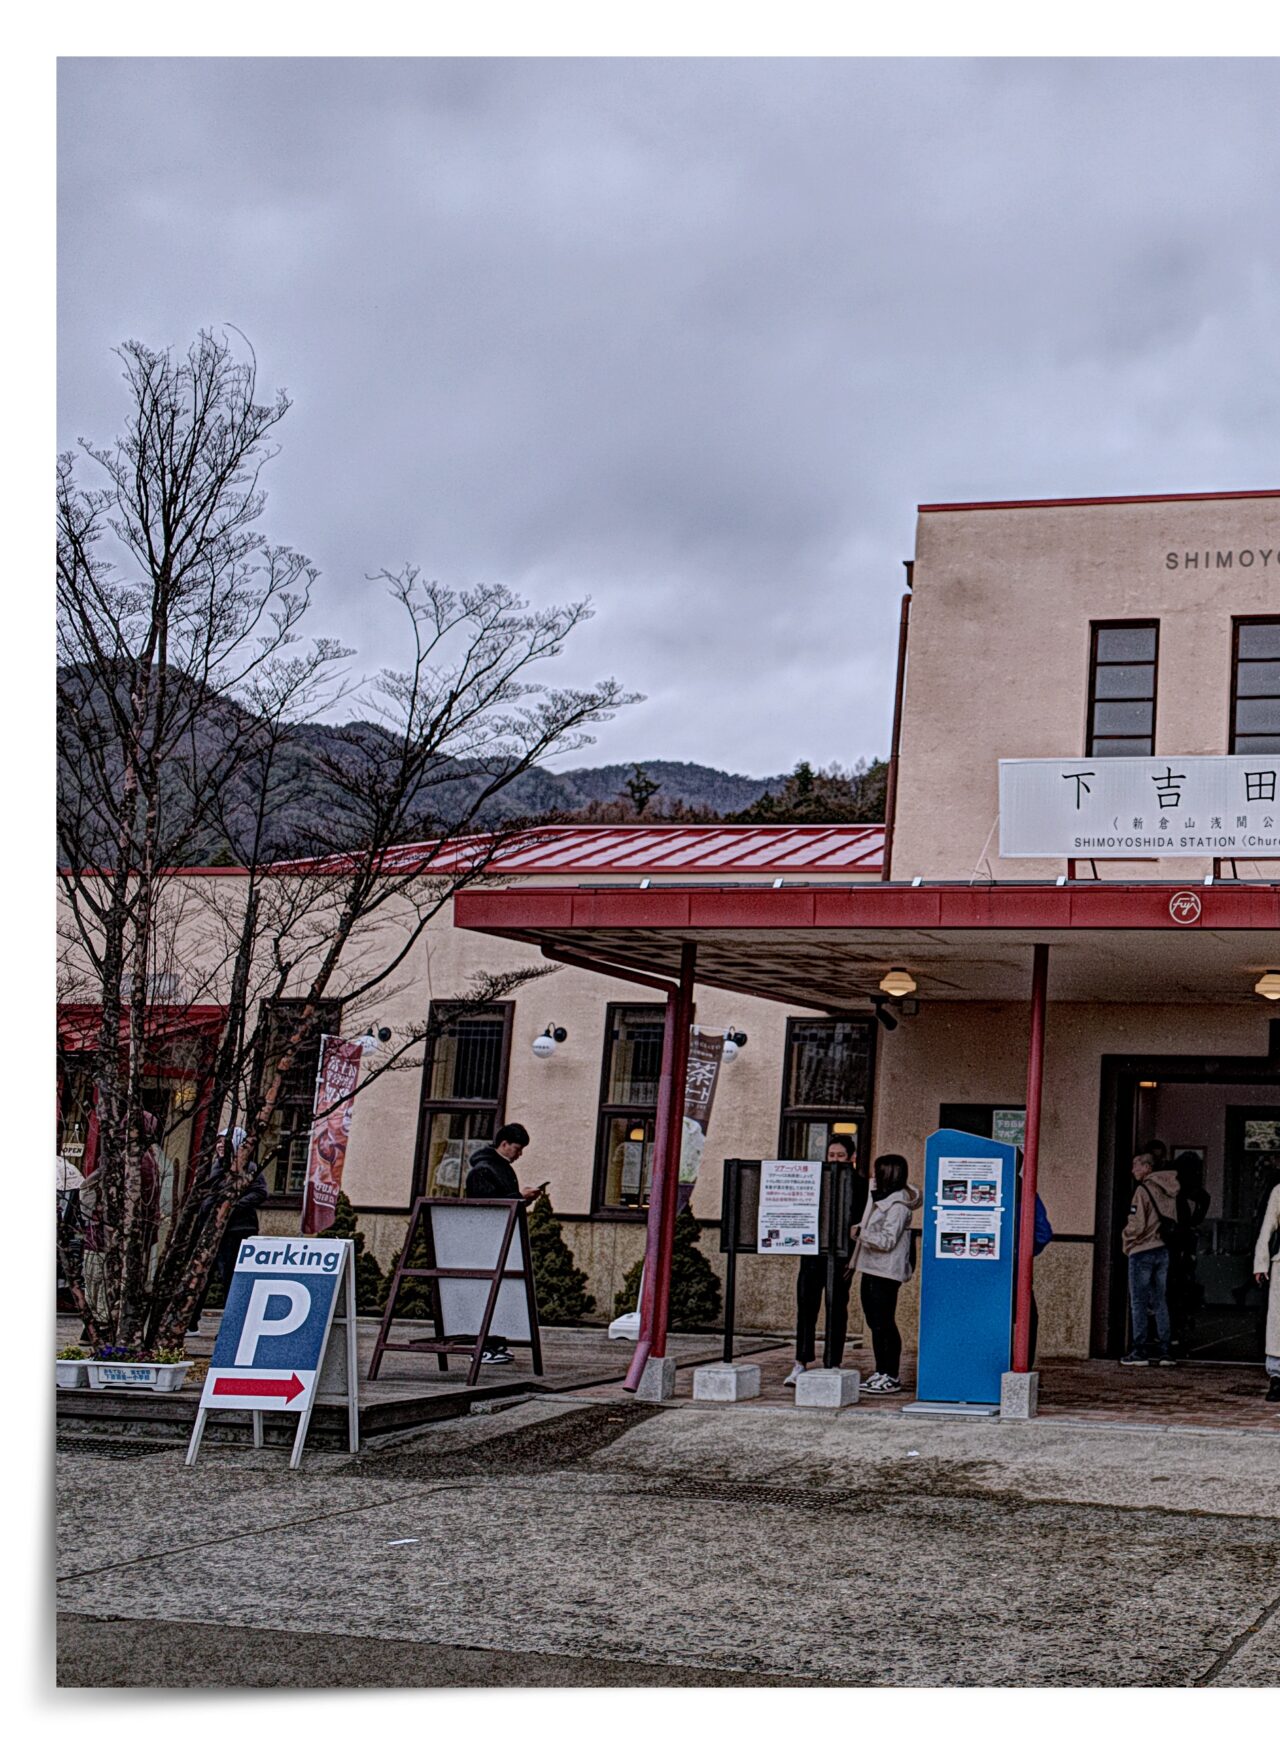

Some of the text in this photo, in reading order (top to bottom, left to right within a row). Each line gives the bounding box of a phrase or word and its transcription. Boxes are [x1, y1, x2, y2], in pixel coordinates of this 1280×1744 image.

[1074, 837, 1174, 848] SHIMOYOSHIDA
[1180, 836, 1236, 847] STATION
[238, 1243, 340, 1273] Parking
[233, 1279, 312, 1366] P
